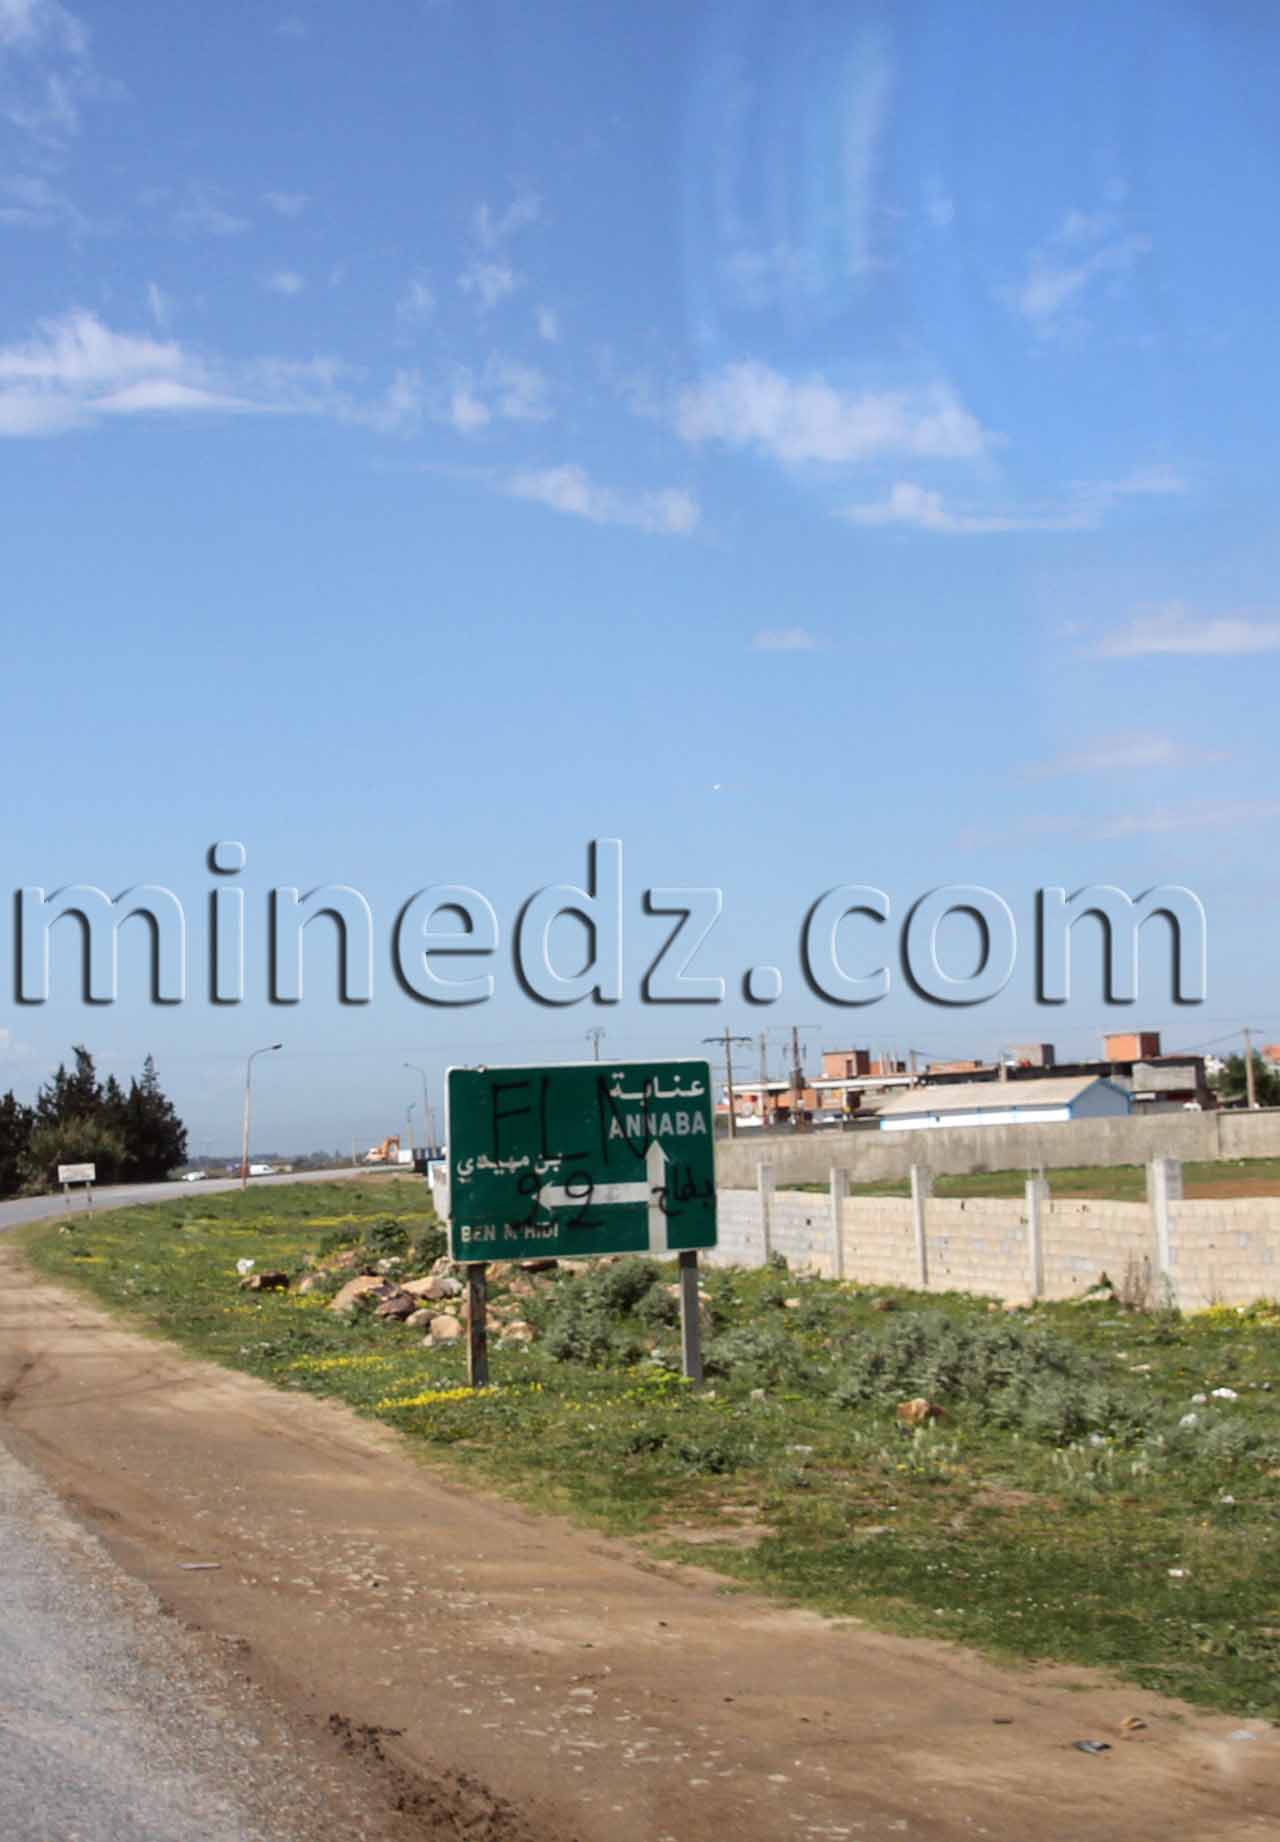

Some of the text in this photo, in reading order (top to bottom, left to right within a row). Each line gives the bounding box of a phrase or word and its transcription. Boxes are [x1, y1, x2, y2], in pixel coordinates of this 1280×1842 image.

[609, 1072, 705, 1107] عنابة
[608, 1110, 707, 1140] ANNABA
[461, 1224, 497, 1243] BEN
